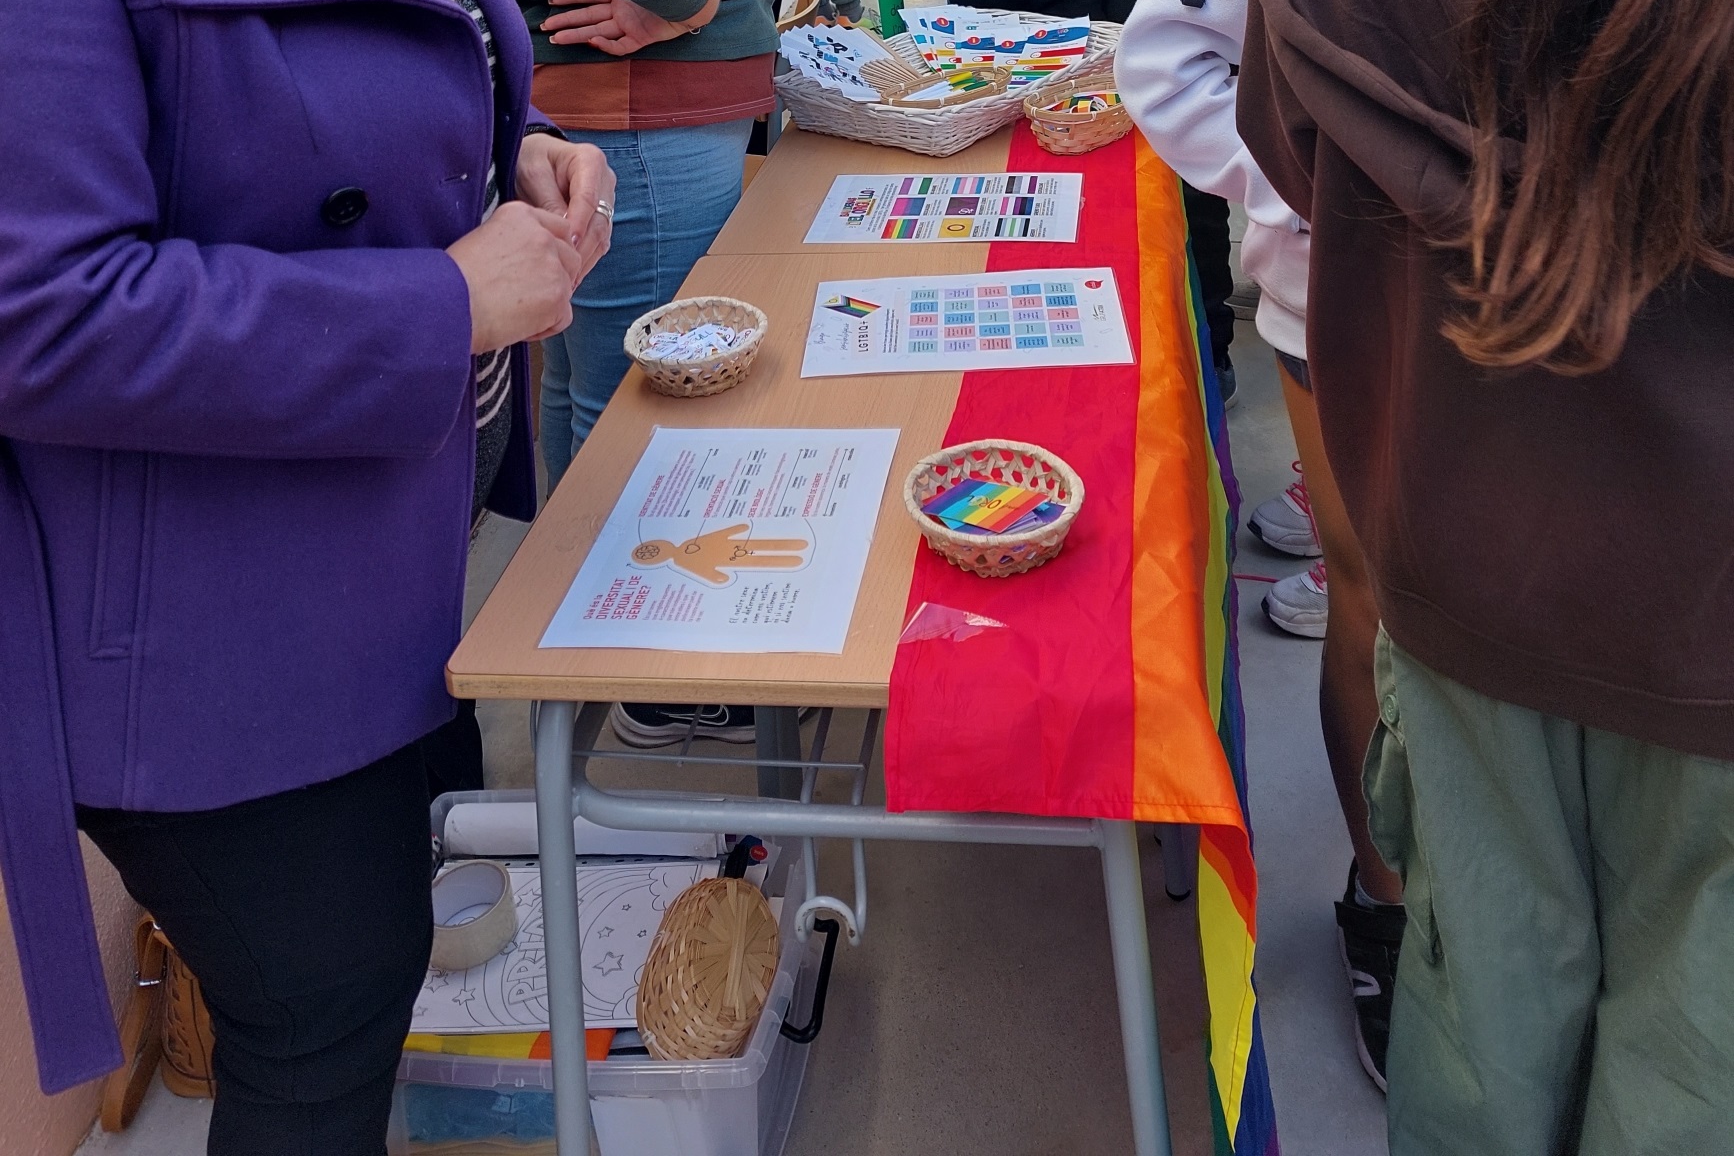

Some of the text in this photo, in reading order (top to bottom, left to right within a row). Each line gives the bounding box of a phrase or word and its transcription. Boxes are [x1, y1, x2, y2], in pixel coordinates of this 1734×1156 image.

[858, 320, 869, 353] LGTBIQ+
[583, 608, 596, 620] Què
[590, 600, 600, 608] és
[595, 578, 626, 620] DIVERSITAT
[611, 591, 635, 620] SEXUAL
[628, 575, 642, 585] DE
[625, 585, 651, 620] GÈNERE?
